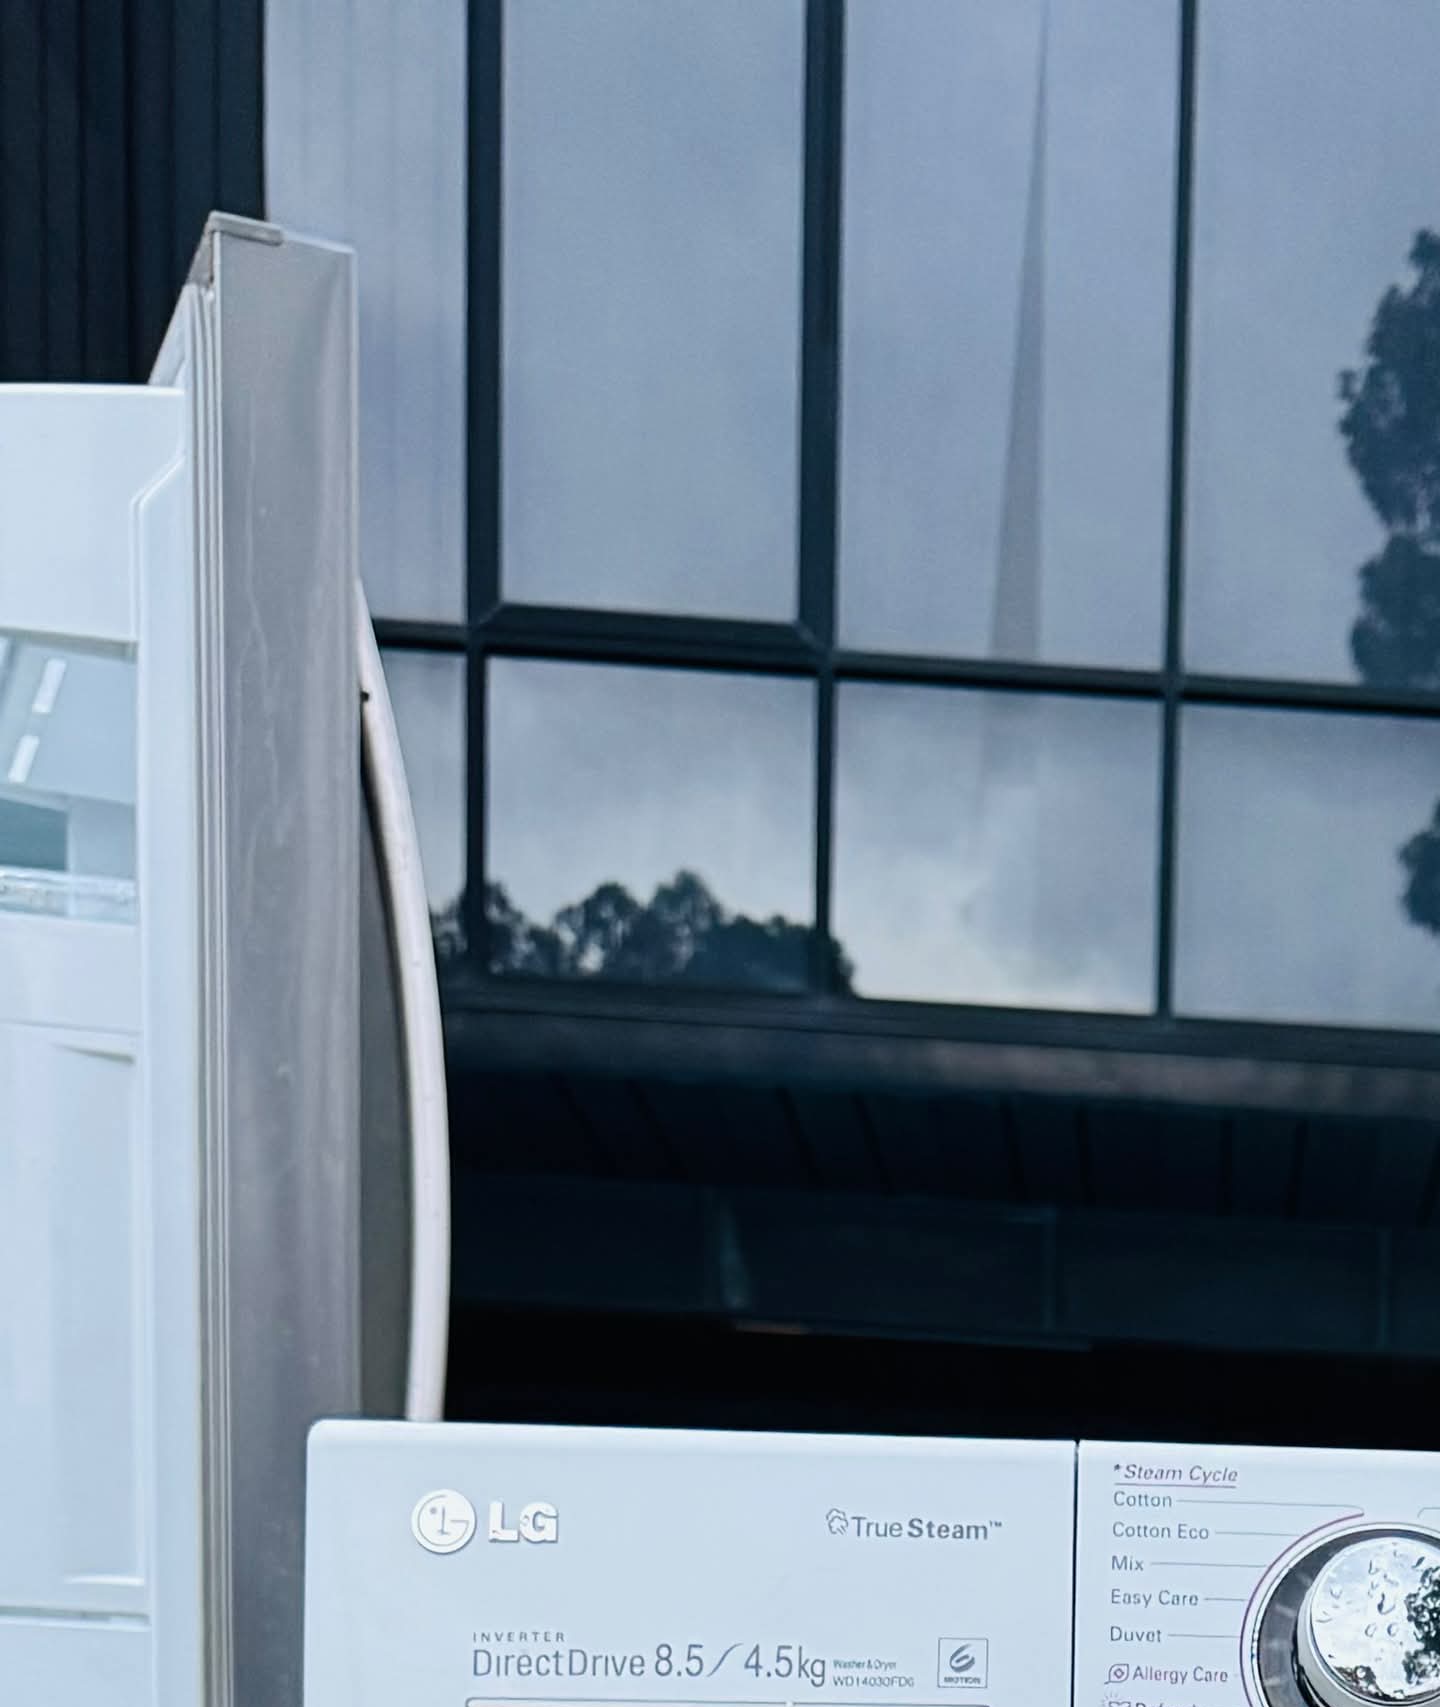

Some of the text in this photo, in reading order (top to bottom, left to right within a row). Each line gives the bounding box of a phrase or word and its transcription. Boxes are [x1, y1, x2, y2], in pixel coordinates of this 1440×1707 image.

[1189, 1465, 1238, 1484] Cycle
[1113, 1490, 1172, 1507] Cotton
[488, 1500, 559, 1543] LG
[1112, 1521, 1209, 1539] Cotton Eco
[1111, 1555, 1144, 1571] Mix
[1111, 1588, 1199, 1608] Easy Care
[472, 1631, 565, 1642] INVERTER
[1110, 1625, 1161, 1643] Duvet
[1132, 1666, 1228, 1685] Allergy Care
